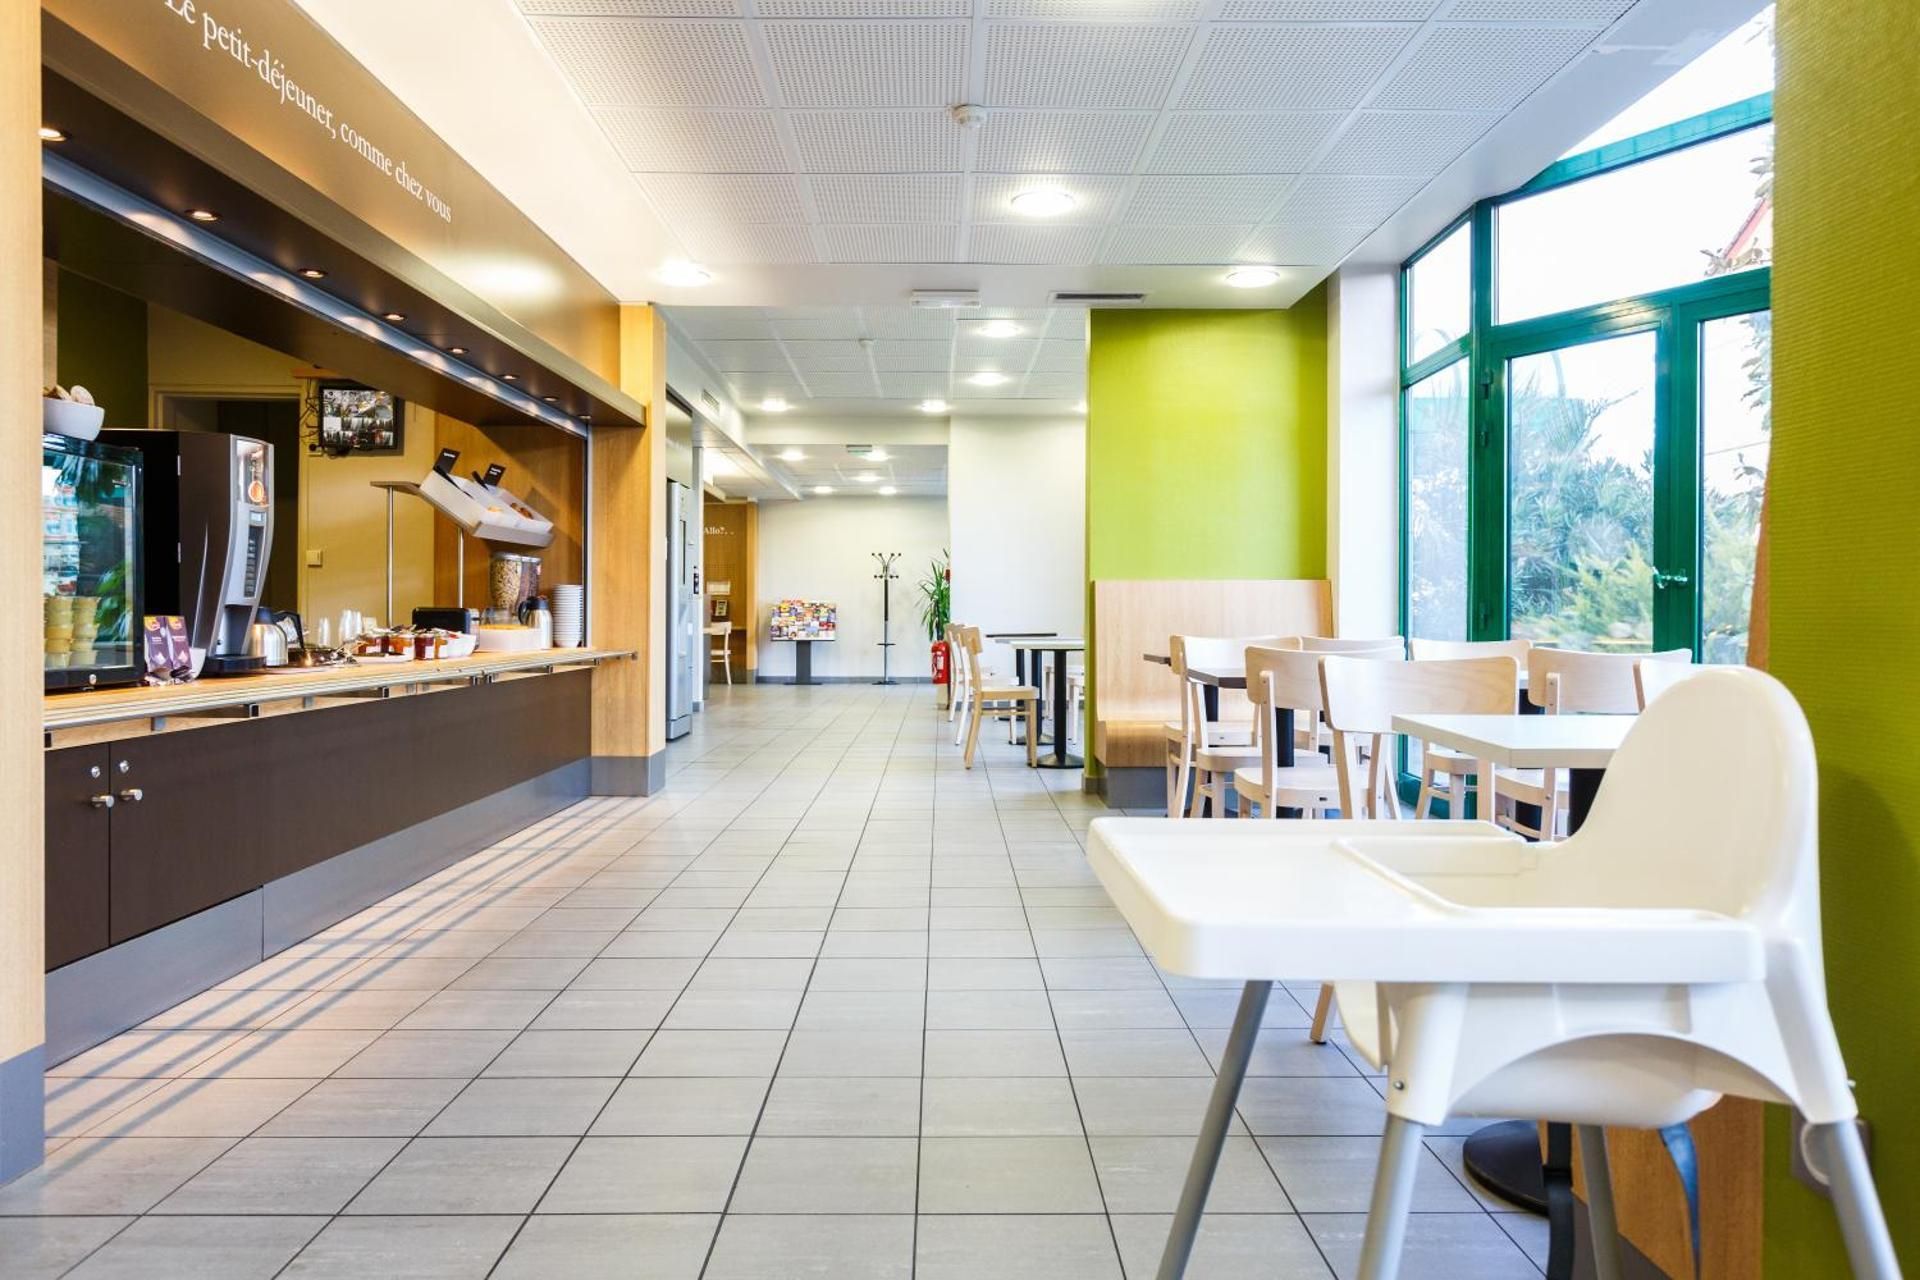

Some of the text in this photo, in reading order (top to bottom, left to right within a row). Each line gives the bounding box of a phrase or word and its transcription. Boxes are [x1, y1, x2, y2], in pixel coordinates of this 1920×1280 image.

[202, 11, 336, 139] petit-déjeuner,
[340, 123, 392, 176] comme
[395, 161, 423, 200] chez
[424, 188, 451, 223] vous
